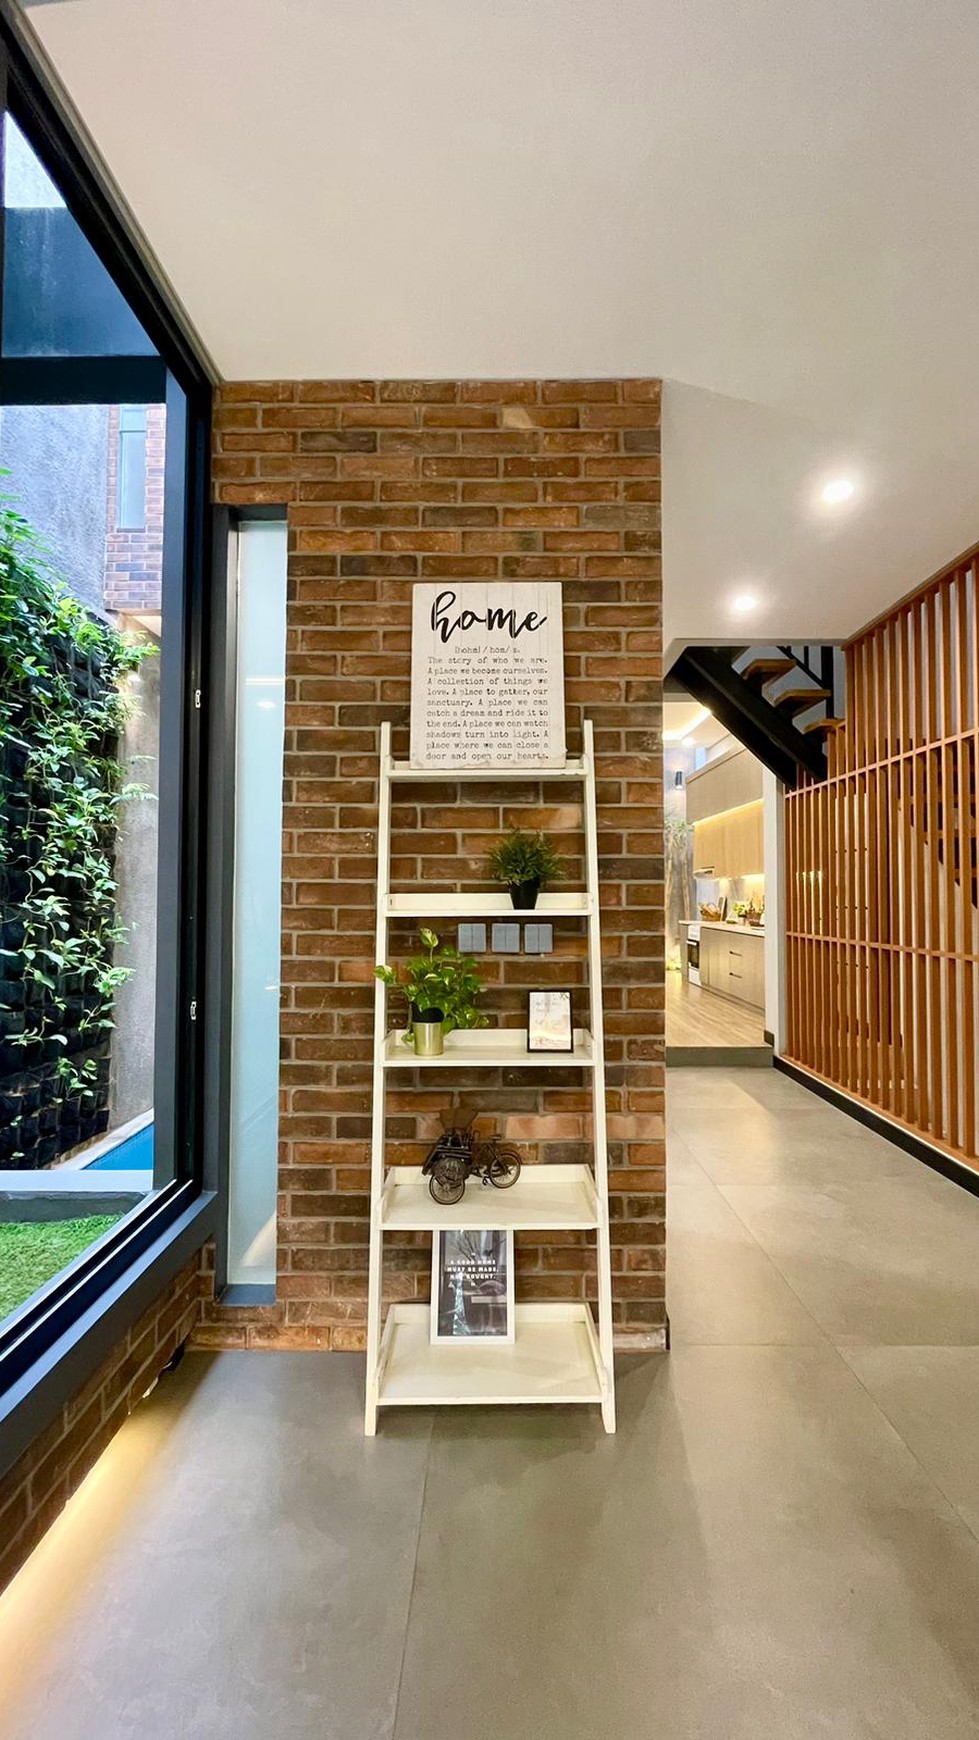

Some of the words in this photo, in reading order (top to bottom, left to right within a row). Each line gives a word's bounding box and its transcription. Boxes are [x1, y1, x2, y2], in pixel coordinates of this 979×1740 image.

[431, 591, 548, 643] home
[489, 698, 512, 706] place
[469, 720, 493, 728] place
[514, 731, 540, 739] light.
